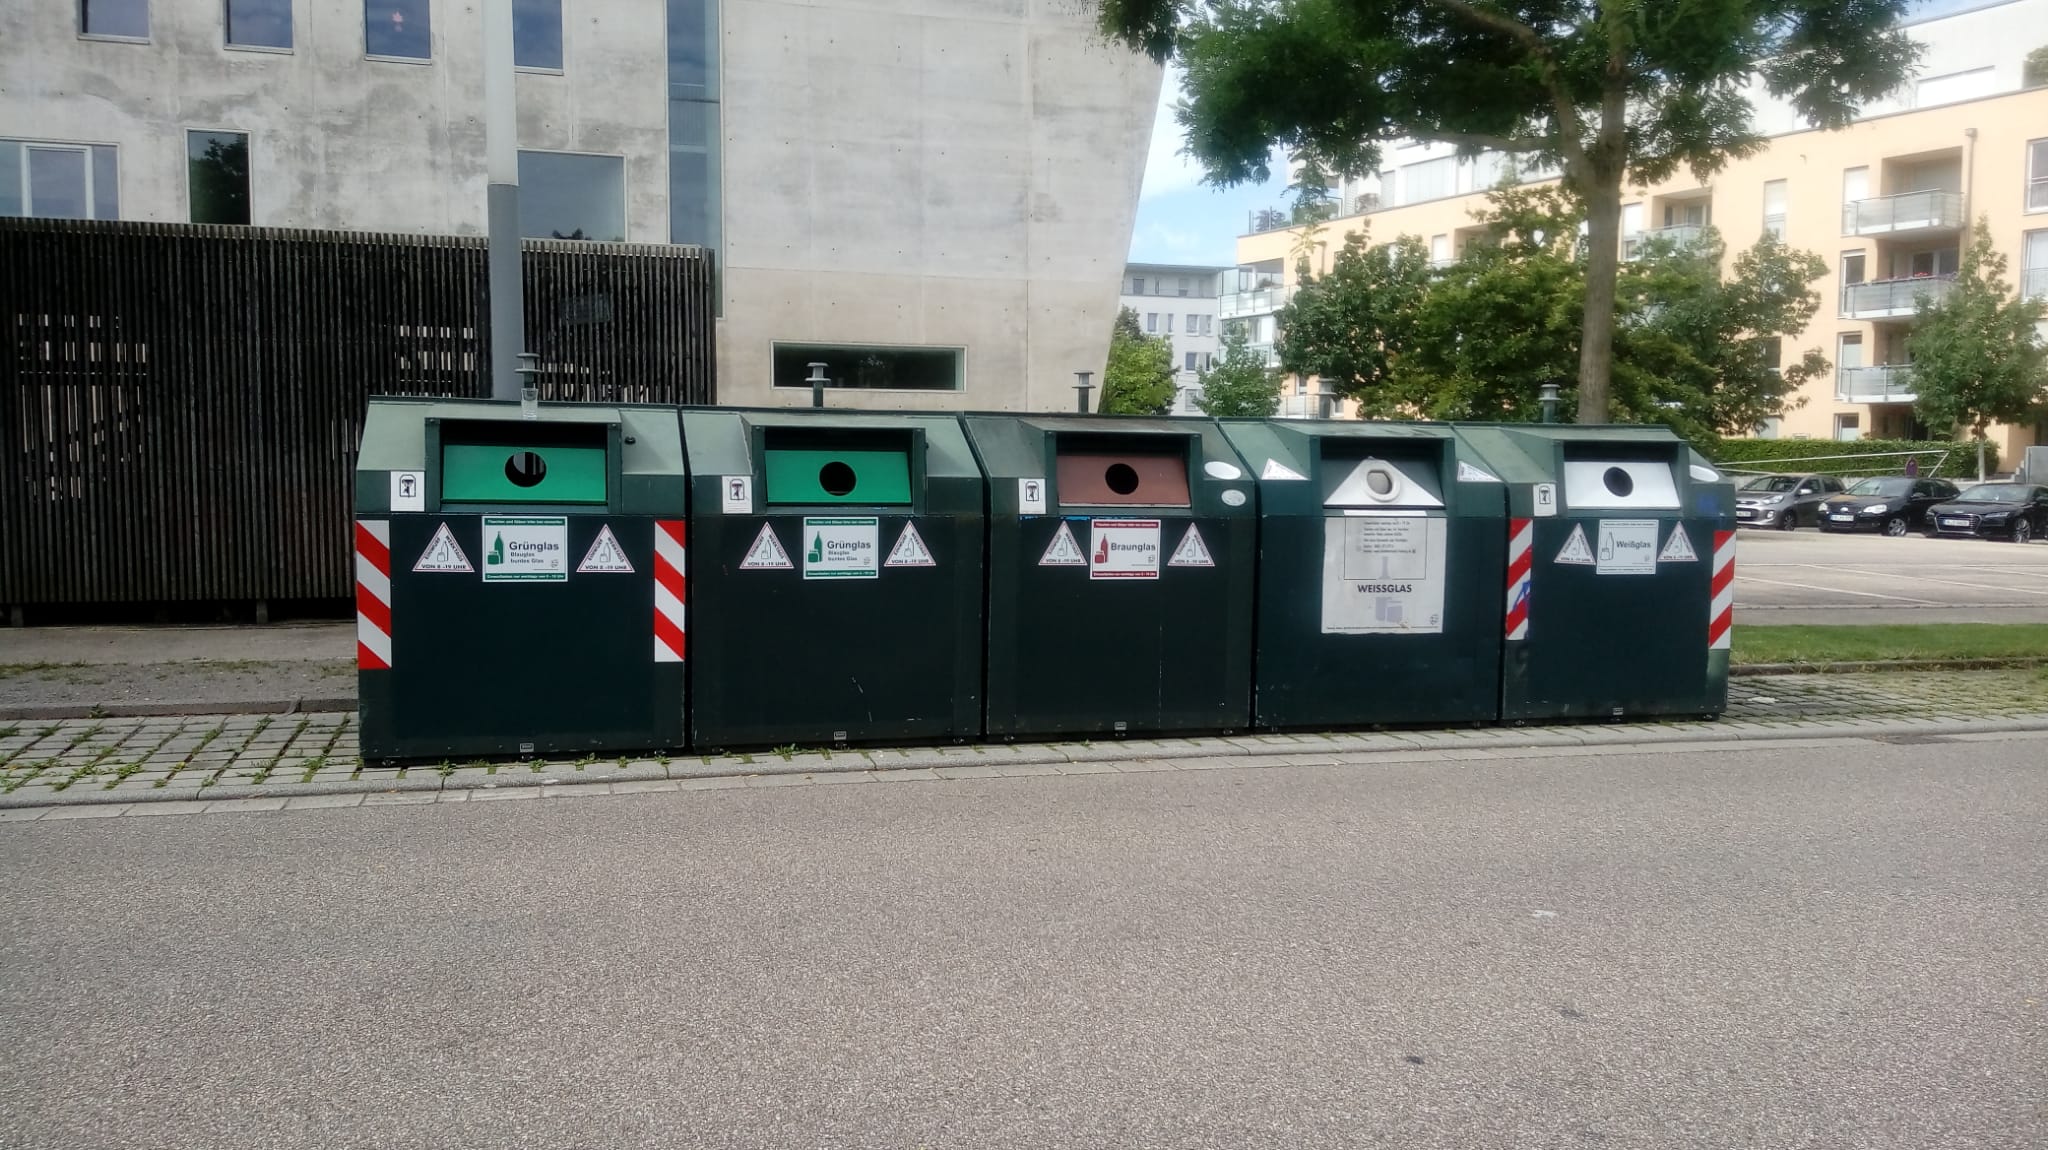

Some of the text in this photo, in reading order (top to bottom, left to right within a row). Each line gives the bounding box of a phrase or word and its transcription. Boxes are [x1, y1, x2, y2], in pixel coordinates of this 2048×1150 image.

[509, 541, 559, 553] Grünglas
[827, 540, 871, 551] Grünglas
[1110, 542, 1156, 552] Braunglas
[1616, 540, 1651, 550] Weißglas
[1357, 584, 1412, 593] WEISSGLAS
